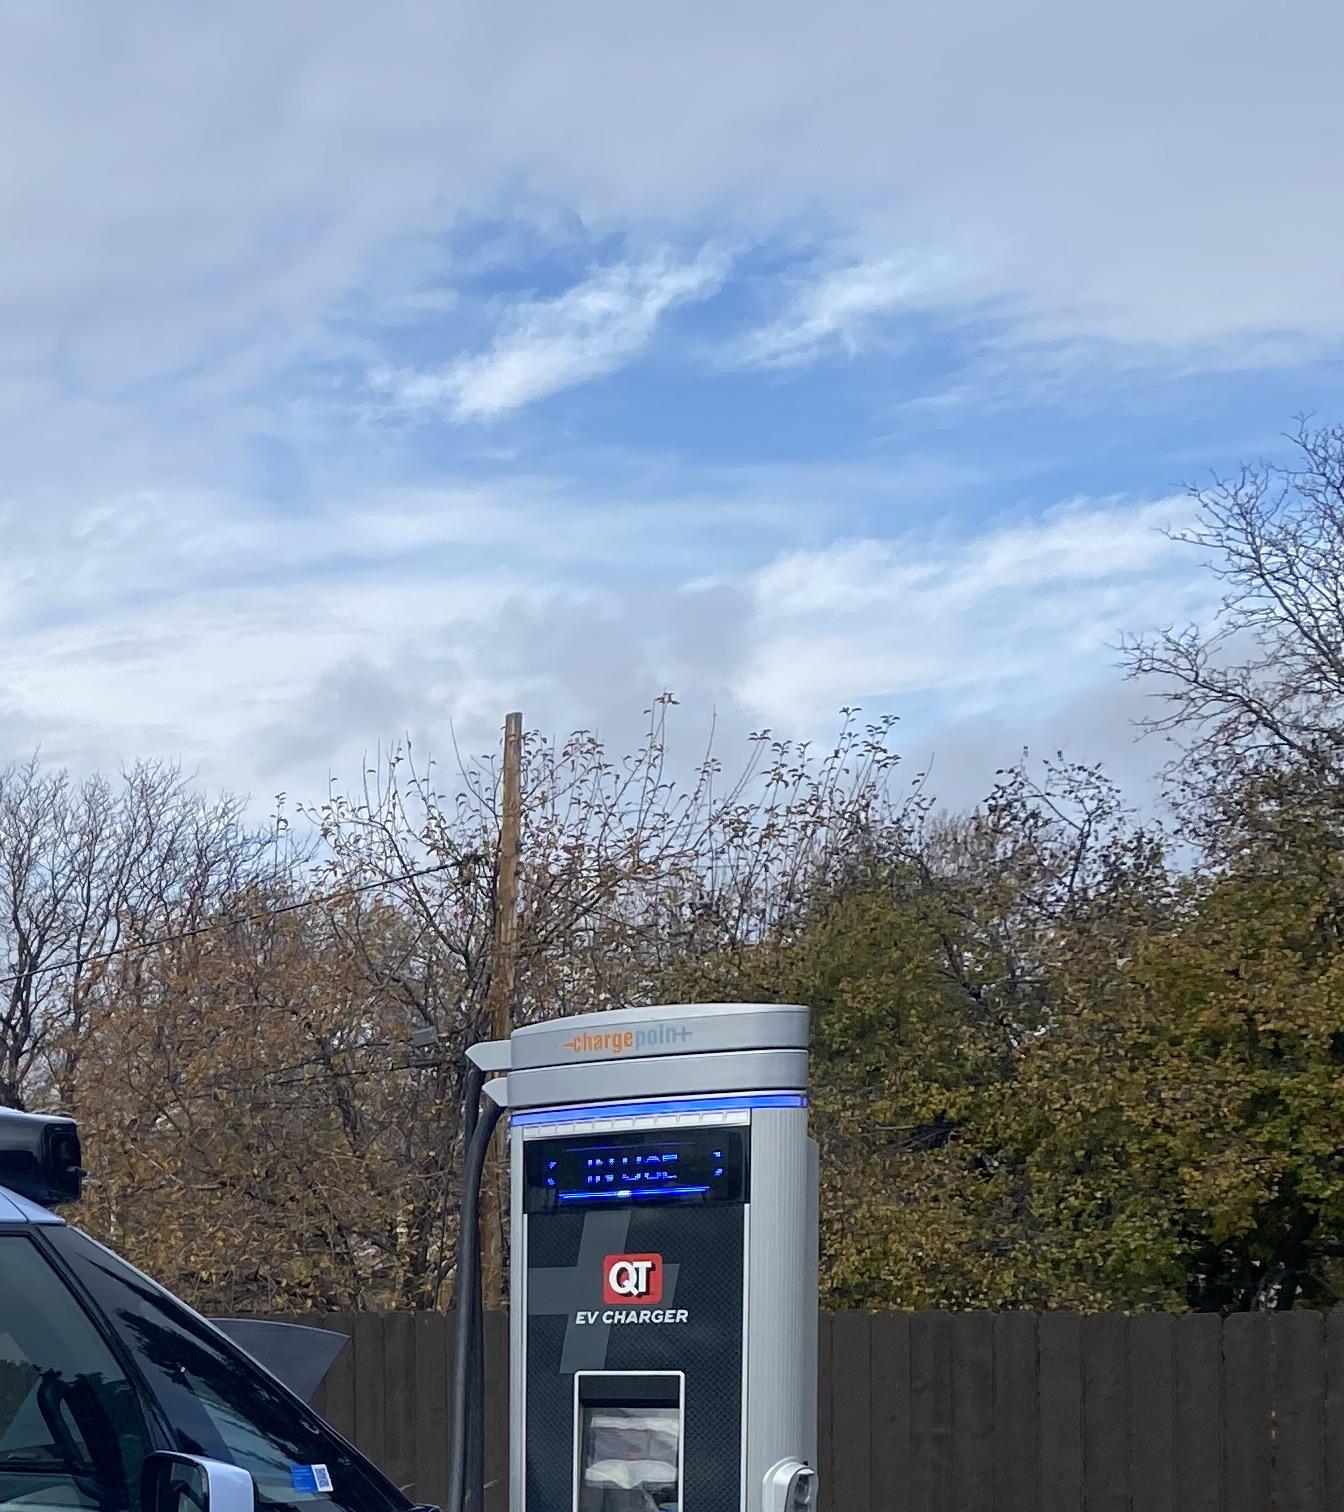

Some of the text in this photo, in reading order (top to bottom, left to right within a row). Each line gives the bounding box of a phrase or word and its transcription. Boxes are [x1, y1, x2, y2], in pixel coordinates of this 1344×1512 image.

[608, 1260, 653, 1296] QT
[575, 1309, 689, 1325] EV CHARGER
